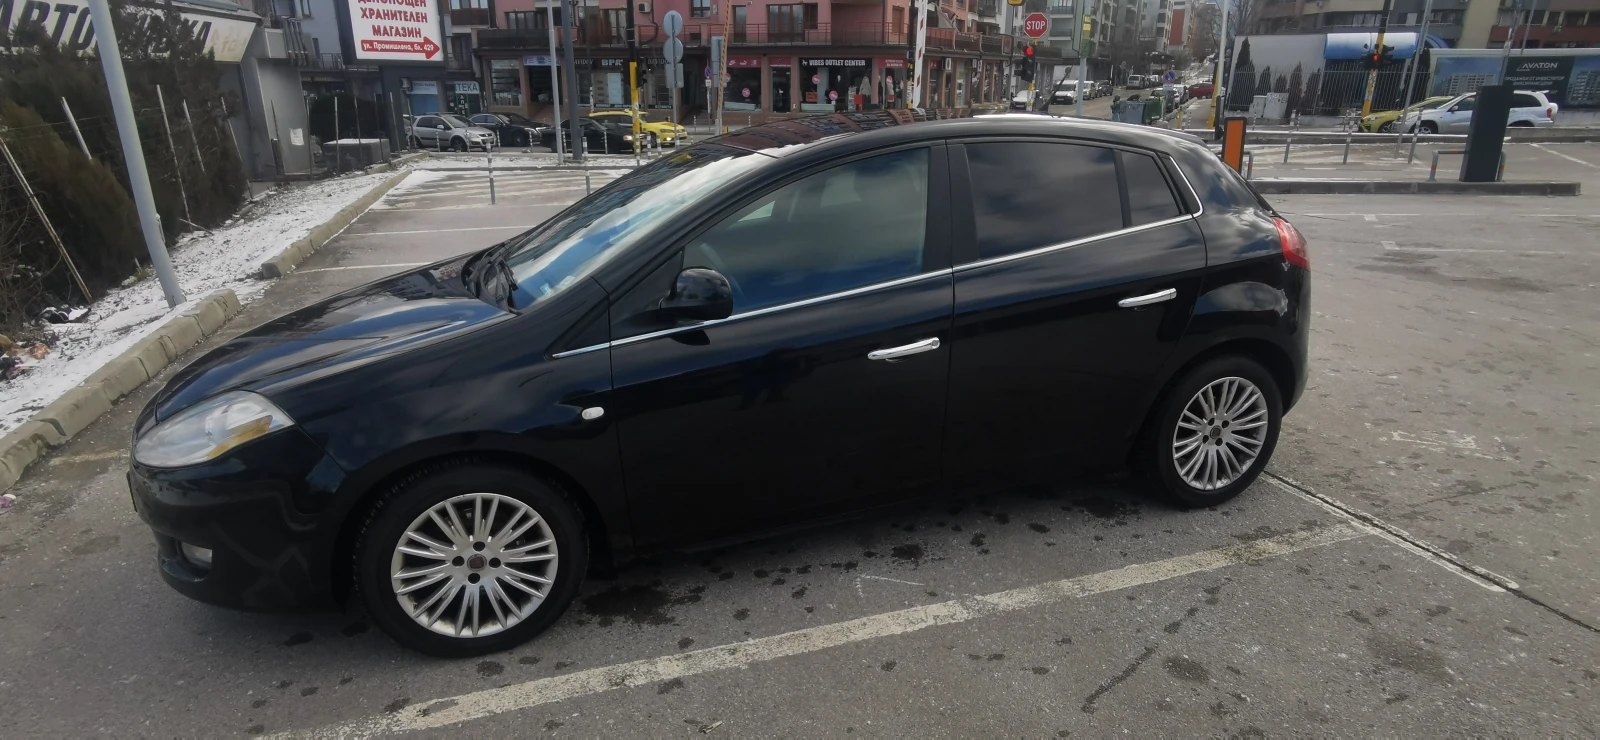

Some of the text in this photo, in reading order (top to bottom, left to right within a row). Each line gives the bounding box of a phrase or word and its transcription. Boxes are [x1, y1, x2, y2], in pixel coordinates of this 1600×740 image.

[360, 7, 428, 23] ХРАНИТЕЛЕН
[1026, 21, 1046, 30] STOP
[372, 25, 421, 38] МАГАЗИН
[373, 42, 413, 51] Промишлена,
